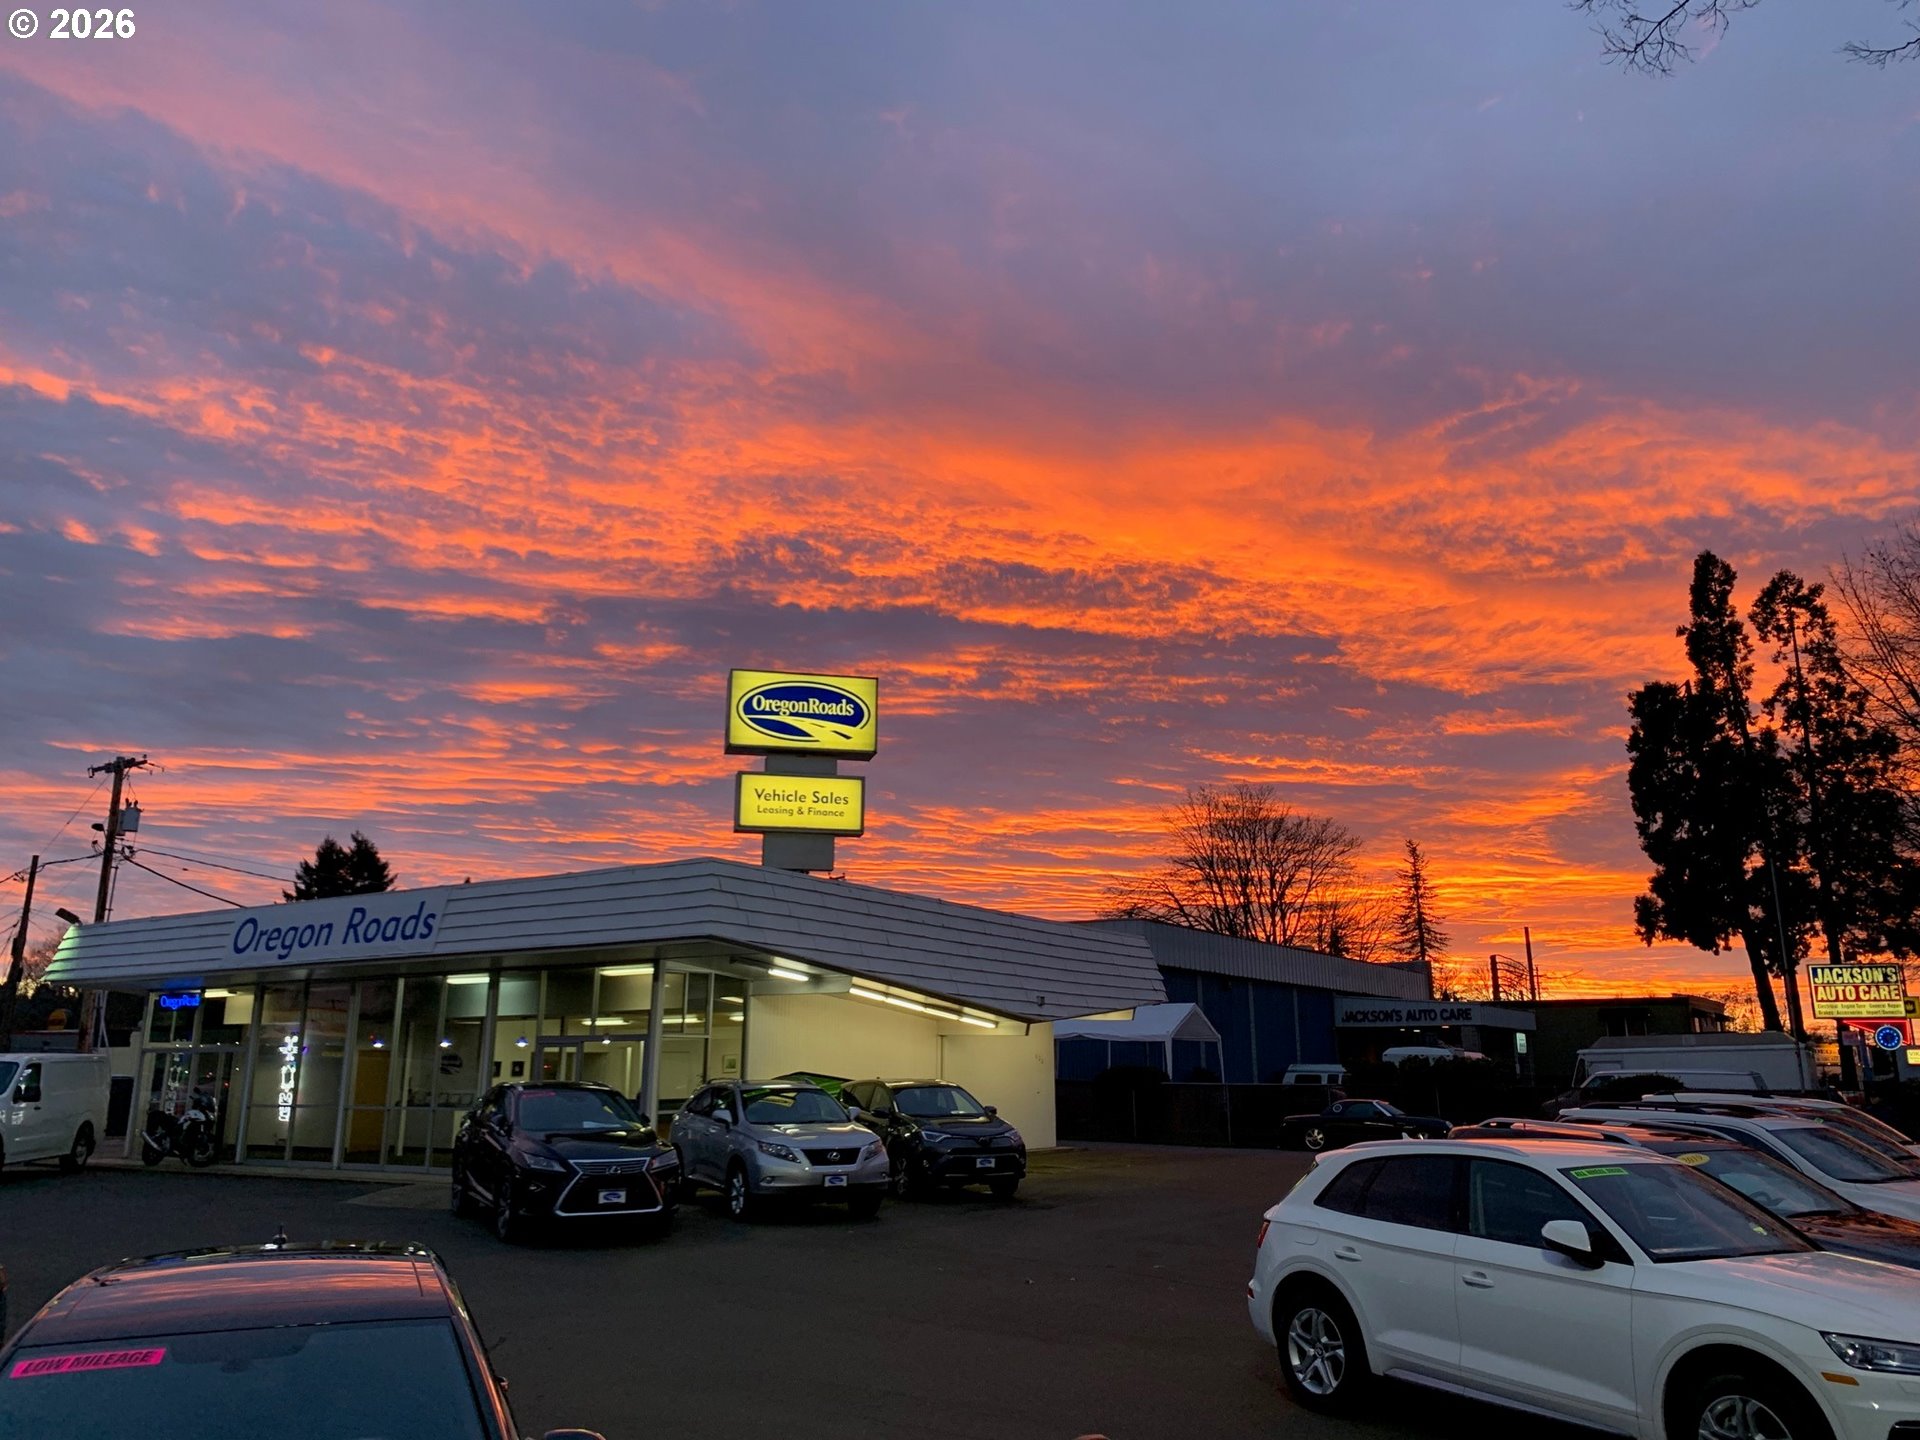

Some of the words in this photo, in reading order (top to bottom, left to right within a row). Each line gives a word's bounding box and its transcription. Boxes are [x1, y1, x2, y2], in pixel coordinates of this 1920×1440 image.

[752, 695, 854, 716] OregonRoads
[755, 788, 806, 803] Vehicle
[812, 791, 849, 805] Sales
[757, 805, 793, 816] Leasing
[797, 806, 804, 815] &
[807, 807, 845, 817] Finance
[233, 917, 333, 960] Oregon
[342, 900, 437, 945] Roads
[1815, 967, 1897, 983] JACKSON'S
[1817, 985, 1856, 1000] AUTO
[1859, 985, 1900, 1000] CARE
[1343, 1009, 1402, 1022] JACKSON'S
[1406, 1009, 1437, 1022] AUTO
[1440, 1008, 1472, 1021] CARE
[22, 1358, 68, 1374] LOW
[68, 1351, 153, 1369] MILEAGE
